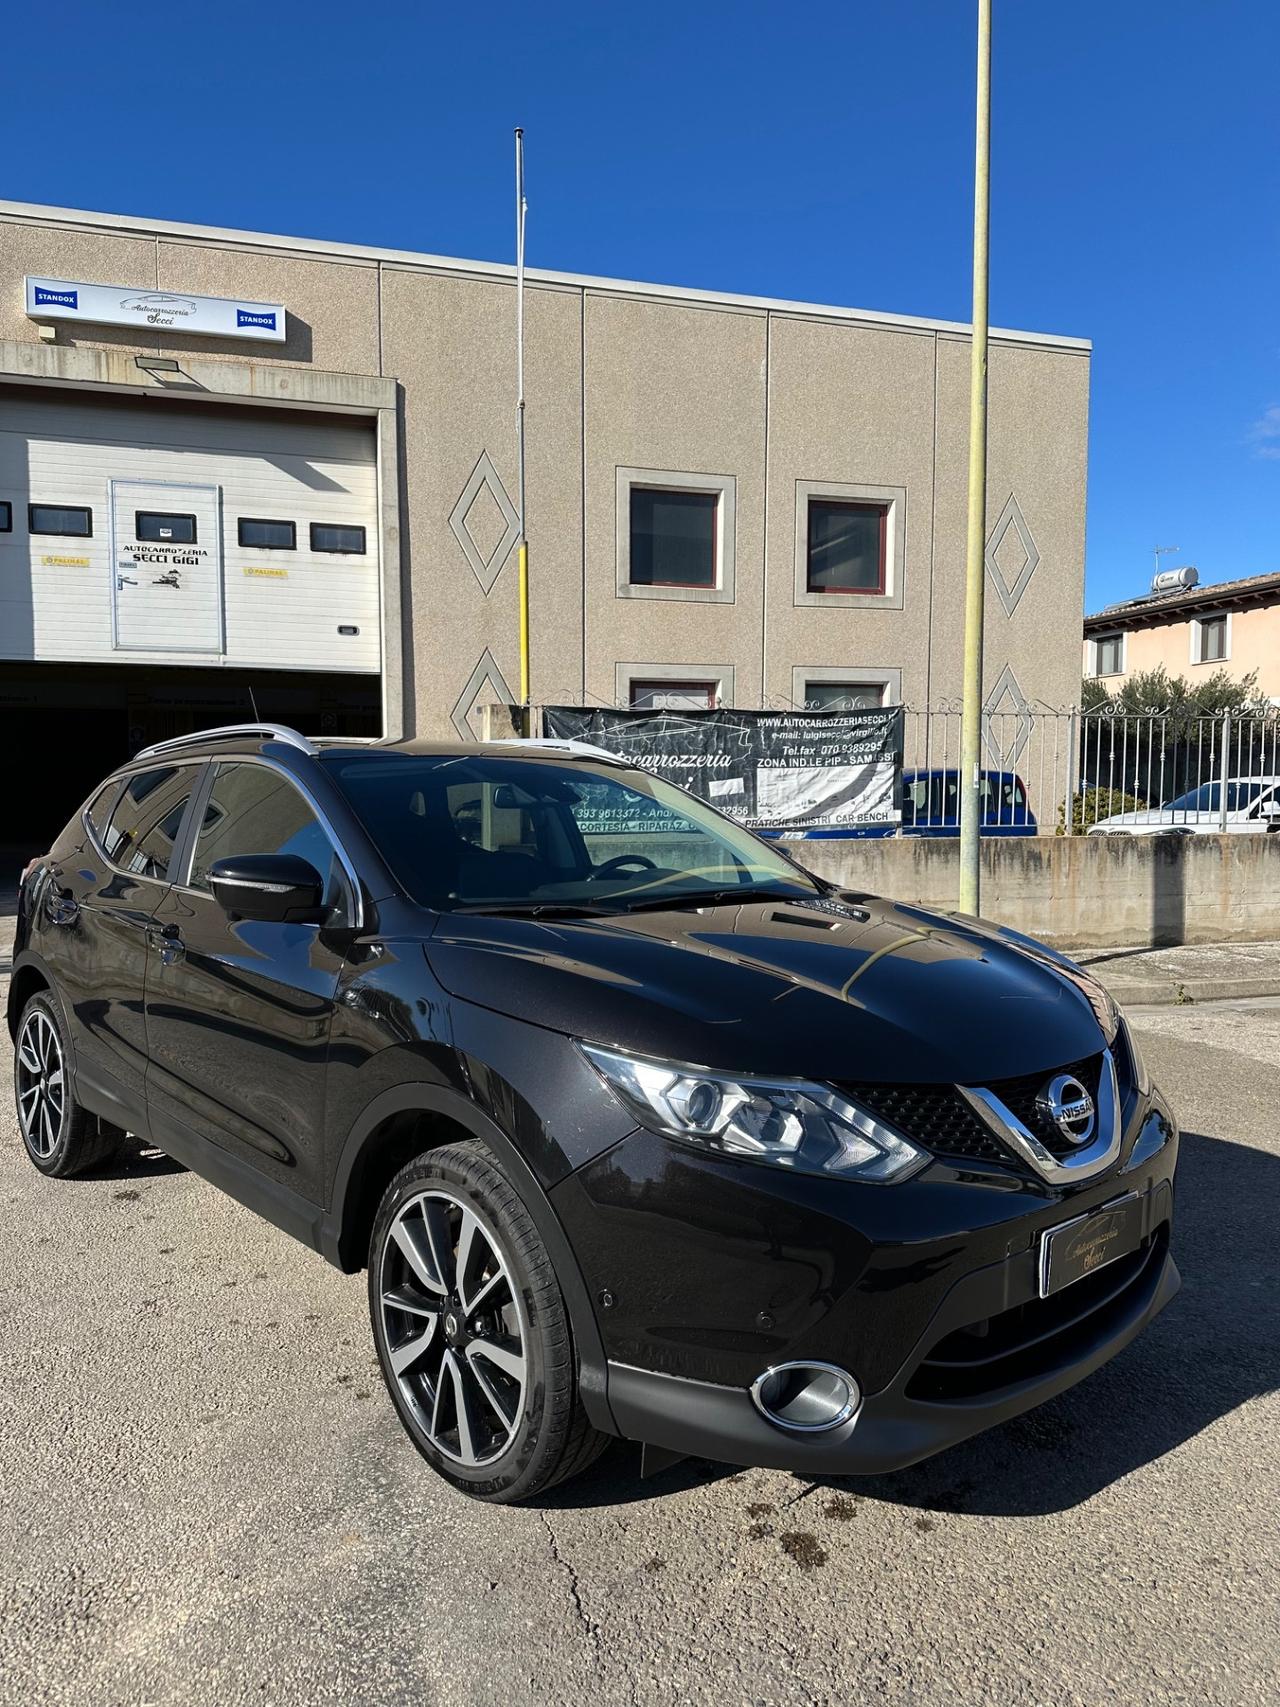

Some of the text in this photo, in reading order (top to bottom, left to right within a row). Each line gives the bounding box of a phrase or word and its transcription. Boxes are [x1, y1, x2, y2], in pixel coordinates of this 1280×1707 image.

[38, 293, 75, 304] STANDOX
[131, 304, 189, 316] Autocarrozzeria
[147, 313, 174, 325] Secci
[239, 315, 273, 325] STANDOX
[133, 554, 199, 565] SECCI GIGI
[772, 730, 801, 739] e-mail:
[782, 745, 816, 756] Tel.fax
[821, 746, 839, 756] 070
[617, 750, 732, 767] tocarrozzeria
[757, 758, 787, 768] ZONA
[789, 758, 822, 767] IND.LE
[824, 757, 841, 766] PIP
[577, 809, 596, 818] 393
[580, 822, 630, 831] CORTESIA
[745, 818, 793, 828] PRATICHE
[793, 816, 831, 826] SINISTRI
[836, 814, 854, 824] CAR
[857, 812, 888, 822] BENCH
